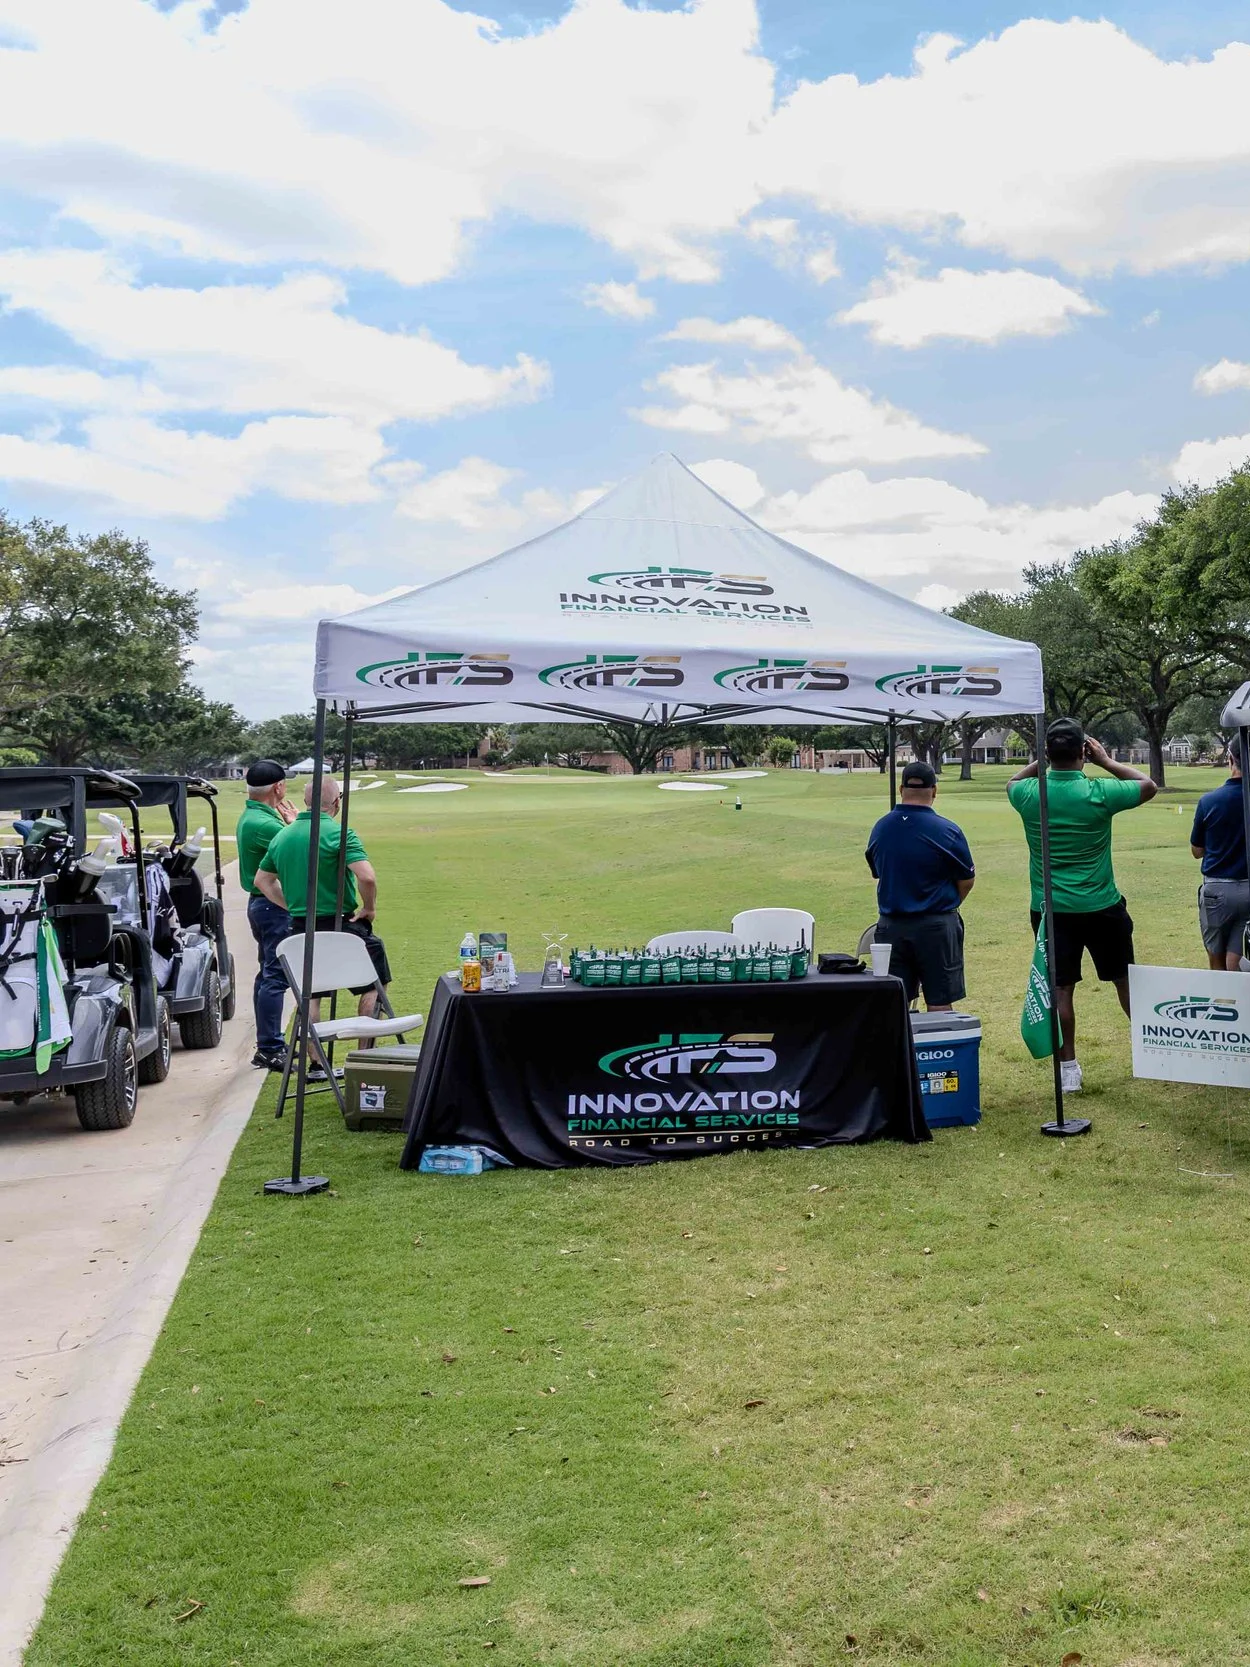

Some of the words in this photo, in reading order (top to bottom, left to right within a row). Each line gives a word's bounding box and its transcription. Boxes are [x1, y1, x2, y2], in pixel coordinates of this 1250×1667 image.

[560, 592, 808, 616] INNOVATION
[561, 604, 688, 615] FINANCIAL
[697, 609, 811, 622] SERVICES
[1143, 1037, 1197, 1049] FINANCIAL
[916, 1050, 954, 1060] IGLOO
[568, 1089, 800, 1115] INNOVATION
[568, 1116, 688, 1131] FINANCIAL
[695, 1113, 800, 1128] SERVICES
[569, 1138, 630, 1147] ROAD
[651, 1137, 676, 1145] TO
[696, 1131, 797, 1144] SUCCES
